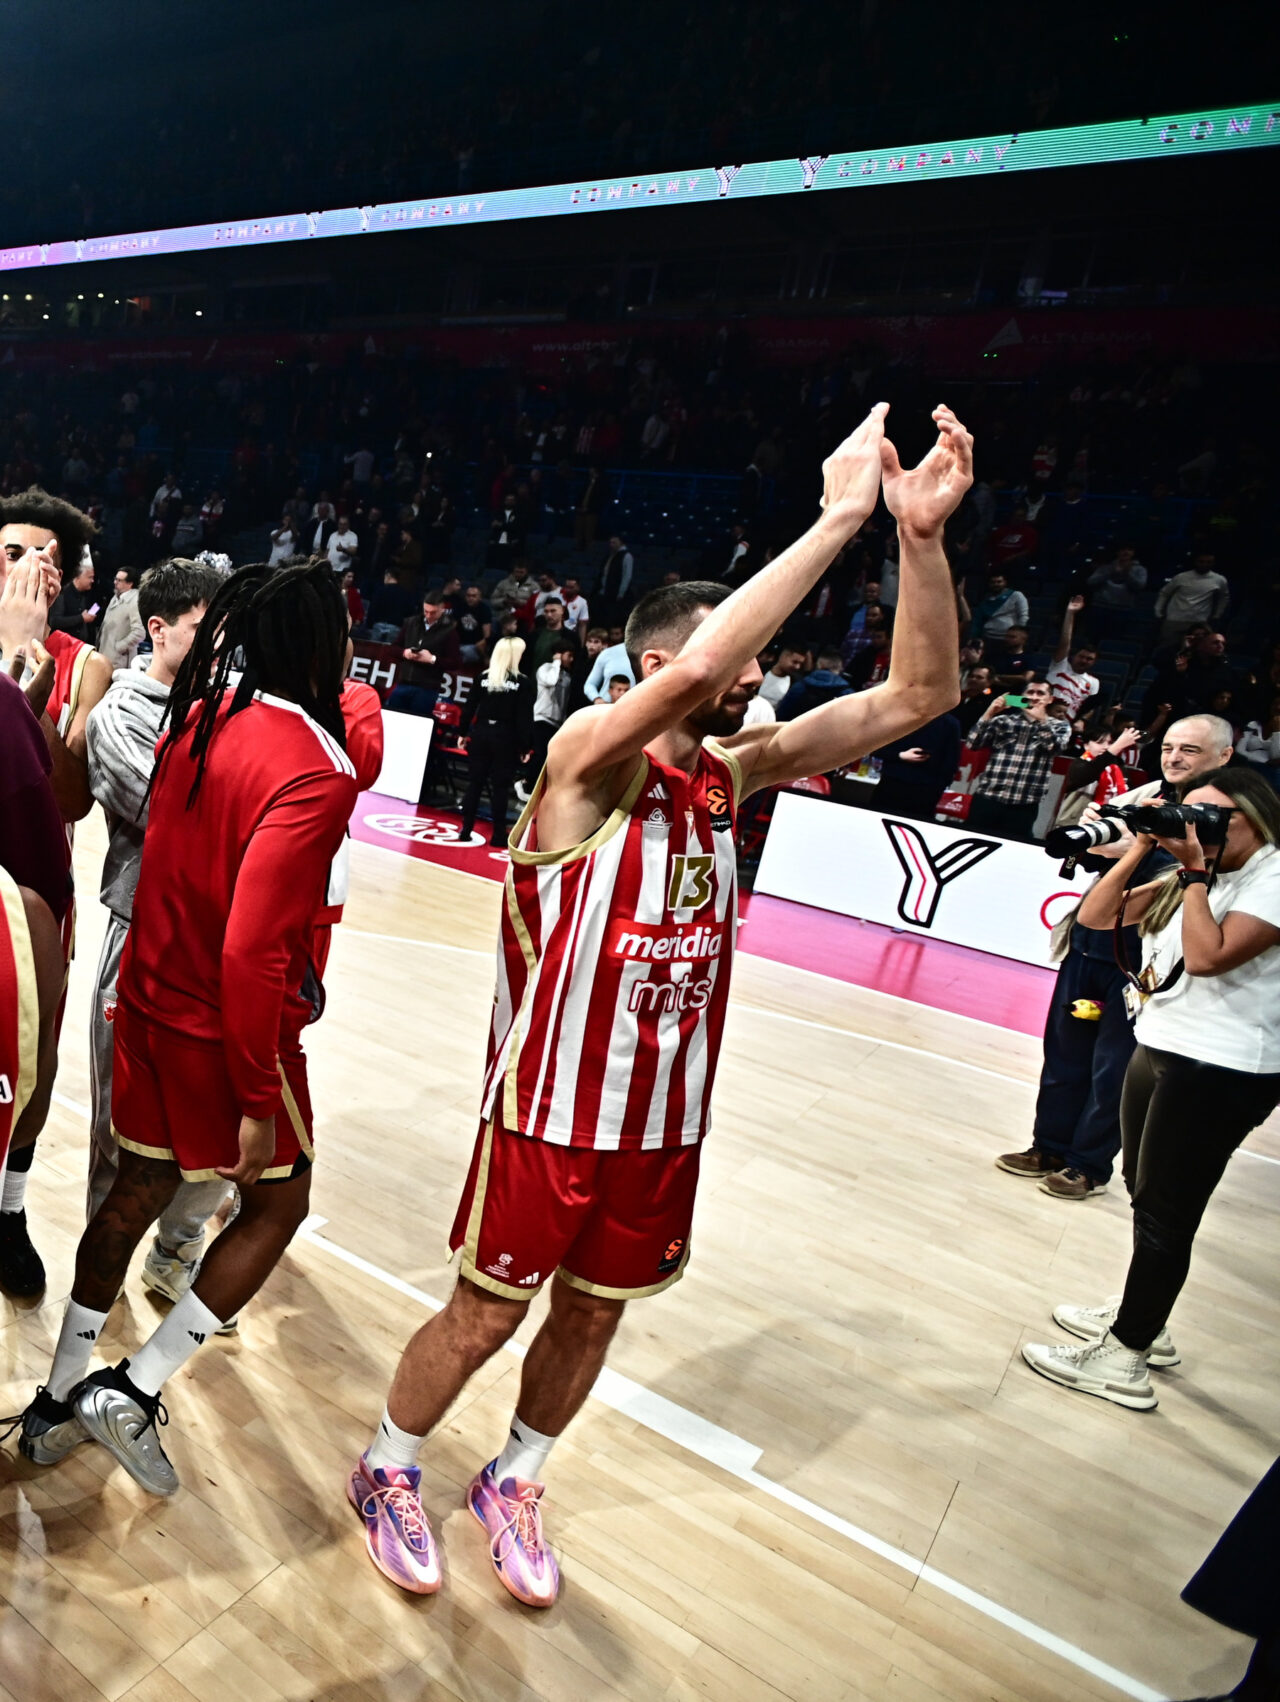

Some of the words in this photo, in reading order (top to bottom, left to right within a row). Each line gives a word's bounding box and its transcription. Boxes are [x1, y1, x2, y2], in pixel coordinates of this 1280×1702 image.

[838, 144, 1011, 177] COMPANY
[570, 177, 700, 205] COMPANY
[381, 200, 486, 223] COMPANY
[214, 220, 297, 240] COMPANY
[667, 854, 715, 910] 13
[629, 972, 712, 1011] mts
